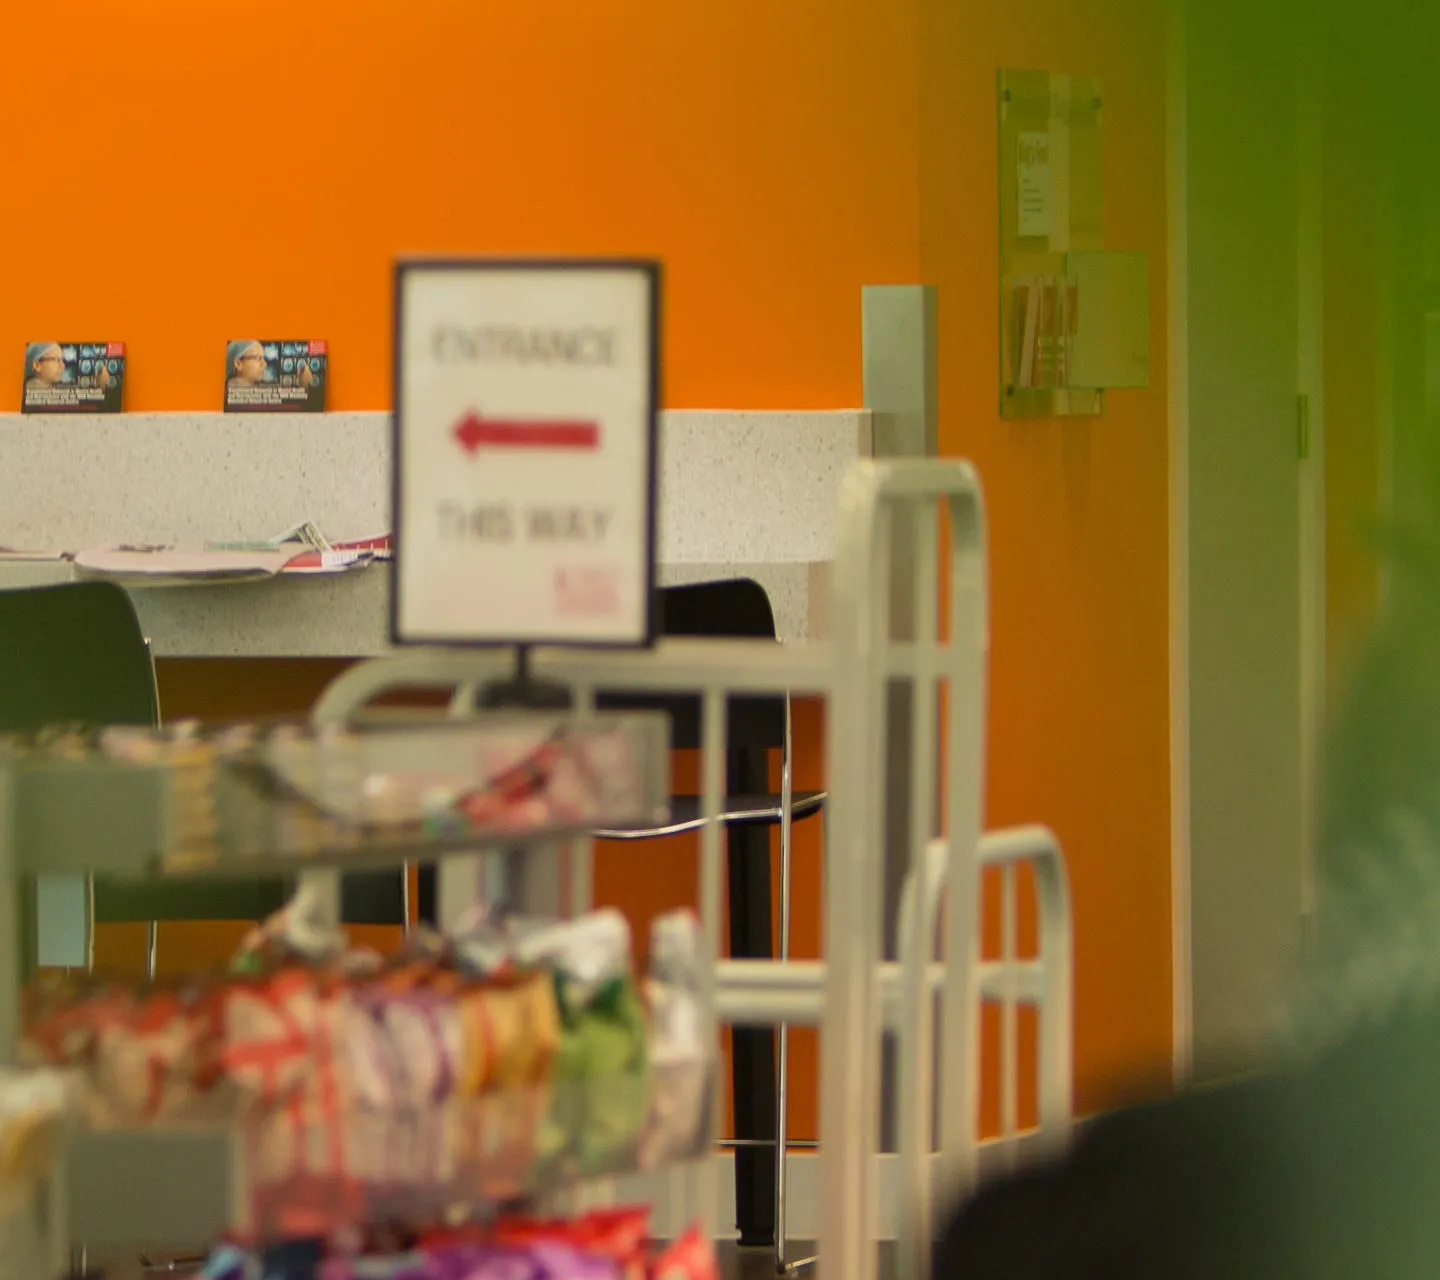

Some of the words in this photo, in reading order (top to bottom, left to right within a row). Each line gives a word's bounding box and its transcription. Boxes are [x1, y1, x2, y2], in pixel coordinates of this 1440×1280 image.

[431, 324, 618, 365] ENTRANCE
[437, 501, 513, 543] THIS
[525, 501, 614, 543] WAY
